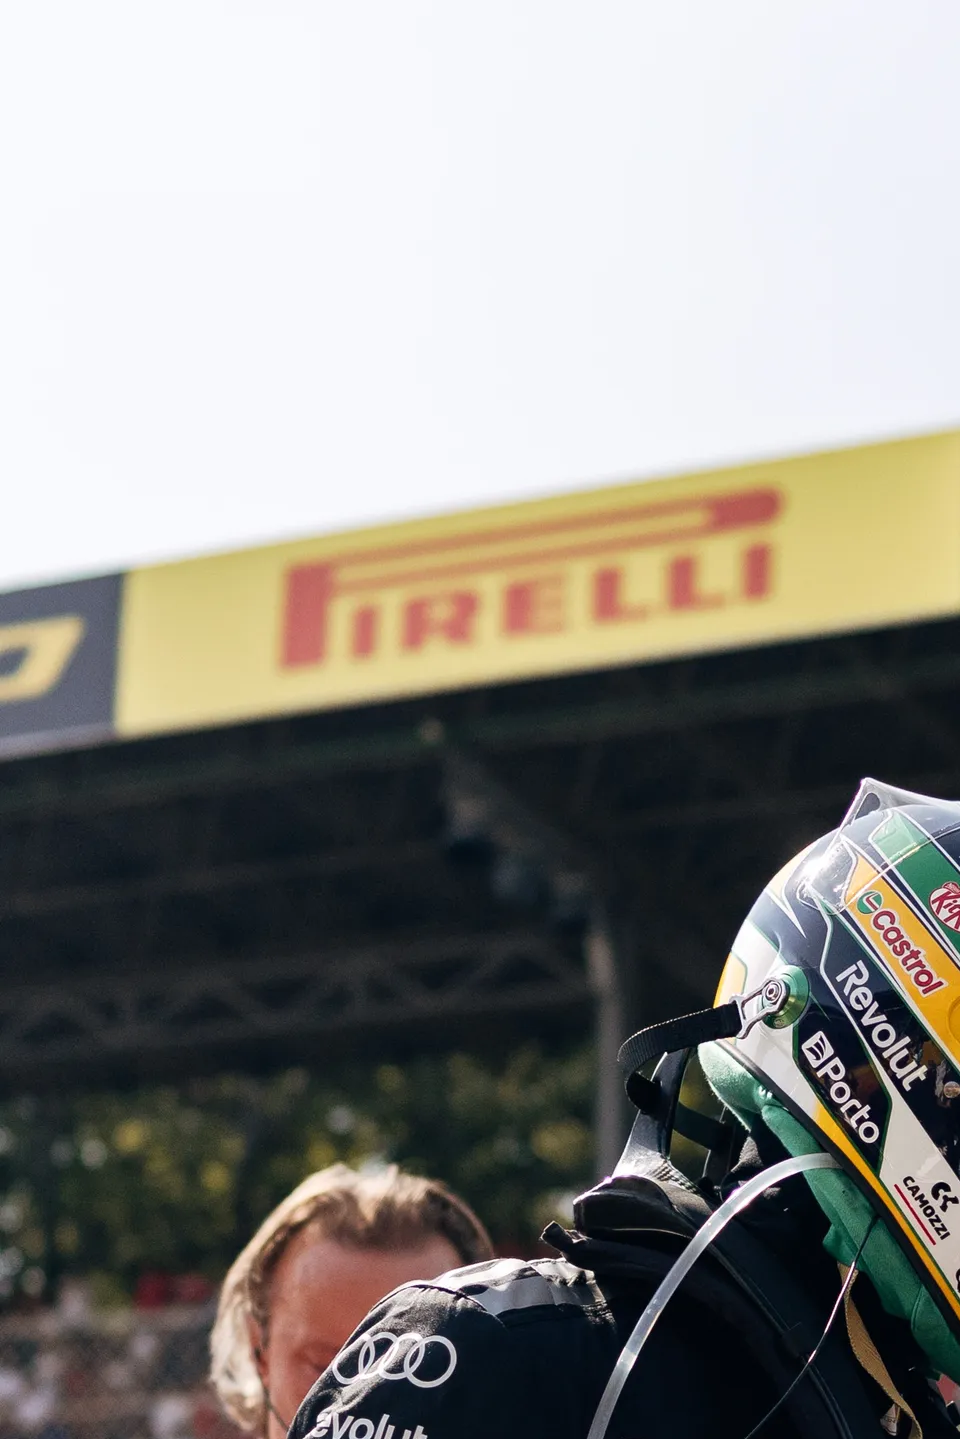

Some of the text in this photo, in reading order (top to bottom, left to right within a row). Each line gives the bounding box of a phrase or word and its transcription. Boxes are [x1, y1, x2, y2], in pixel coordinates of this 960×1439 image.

[277, 485, 785, 673] PIRELLI
[872, 909, 945, 996] Castrol
[836, 959, 929, 1092] Revolut
[902, 1175, 951, 1241] CAMOZZI
